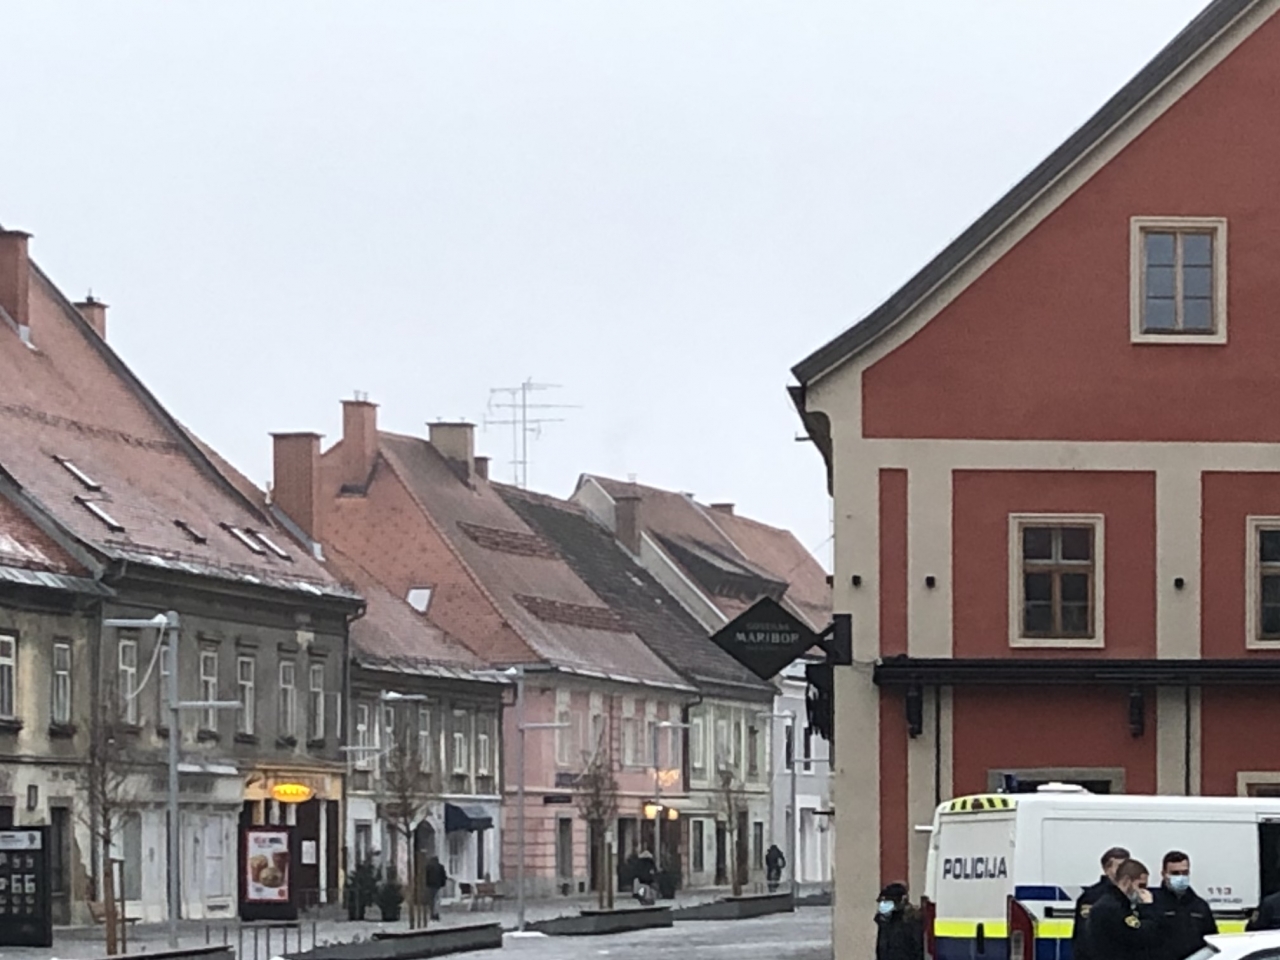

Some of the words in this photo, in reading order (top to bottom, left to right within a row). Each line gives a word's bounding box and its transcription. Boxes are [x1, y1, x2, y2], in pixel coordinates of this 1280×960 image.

[735, 632, 800, 644] MARIBOR
[943, 856, 1008, 880] POLICIJA
[1207, 886, 1232, 896] 113
